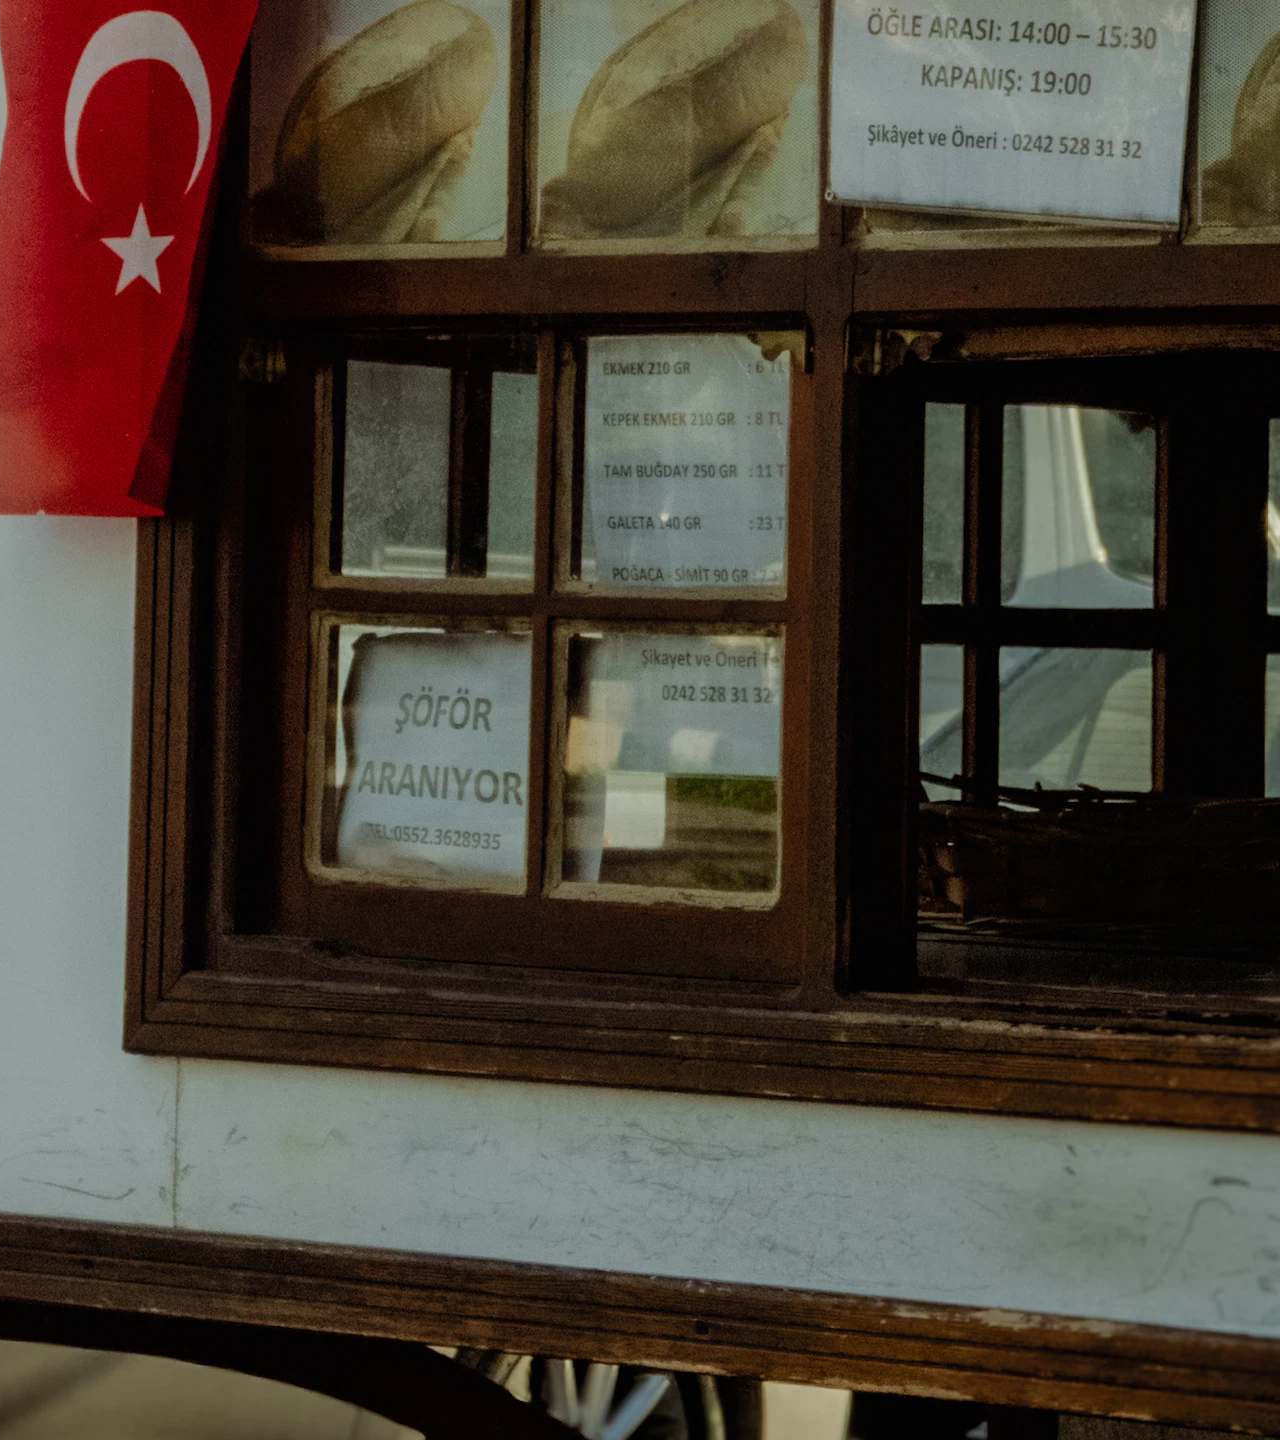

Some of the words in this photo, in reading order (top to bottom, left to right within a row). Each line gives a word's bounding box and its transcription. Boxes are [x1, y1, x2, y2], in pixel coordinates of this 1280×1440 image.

[867, 7, 923, 38] ÖĞLE
[928, 17, 1002, 42] ARASI:
[1009, 21, 1071, 46] 14:00
[1096, 24, 1157, 51] 15:30
[920, 63, 1024, 97] KAPANIŞ:
[1029, 69, 1092, 96] 19:00
[867, 123, 924, 150] Şikâyet
[928, 132, 947, 147] ve
[951, 124, 998, 151] Öneri
[1011, 133, 1054, 154] 0242
[1058, 135, 1091, 156] 528
[1094, 137, 1115, 158] 31
[1120, 139, 1143, 160] 32
[602, 362, 645, 376] EKMEK
[648, 362, 670, 376] 210
[673, 361, 691, 375] GR
[602, 412, 640, 427] KEPEK
[643, 412, 688, 427] EKMEK
[690, 412, 714, 427] 210
[717, 411, 736, 426] GR
[603, 463, 632, 478] TAM
[636, 460, 690, 478] BUĞDAY
[692, 463, 716, 478] 250
[719, 463, 738, 478] GR
[607, 515, 655, 530] GALETA
[683, 516, 702, 531] GR
[713, 569, 729, 583] 90
[731, 569, 749, 583] GR
[695, 655, 711, 667] ve
[661, 684, 696, 702] 0242
[699, 686, 727, 703] 528
[730, 687, 749, 704] 31
[753, 687, 773, 704] 32
[395, 685, 493, 735] ŞÖFÖR
[357, 759, 523, 806] ARANIYOR
